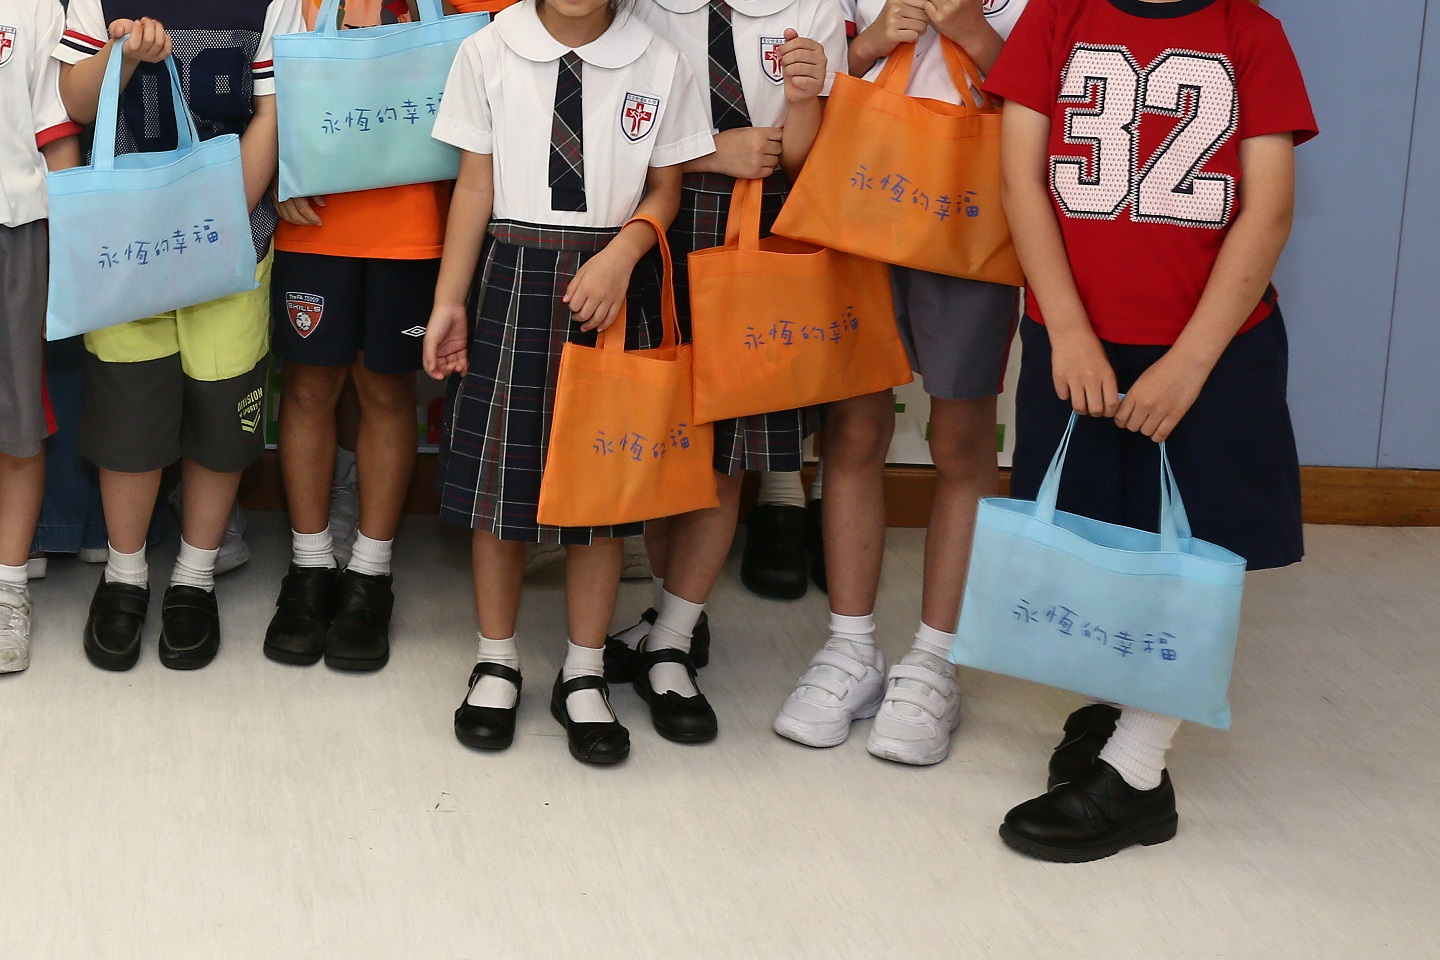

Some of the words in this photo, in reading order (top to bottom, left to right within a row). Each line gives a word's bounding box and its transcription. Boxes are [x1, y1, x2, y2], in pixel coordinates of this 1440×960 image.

[1049, 42, 1240, 229] 32
[849, 165, 979, 221] 永恆的幸福
[98, 219, 219, 268] 永恆的幸福
[288, 302, 321, 312] SKILLS
[744, 305, 859, 349] 永恆的幸福
[1012, 598, 1177, 661] 永恆的幸福
